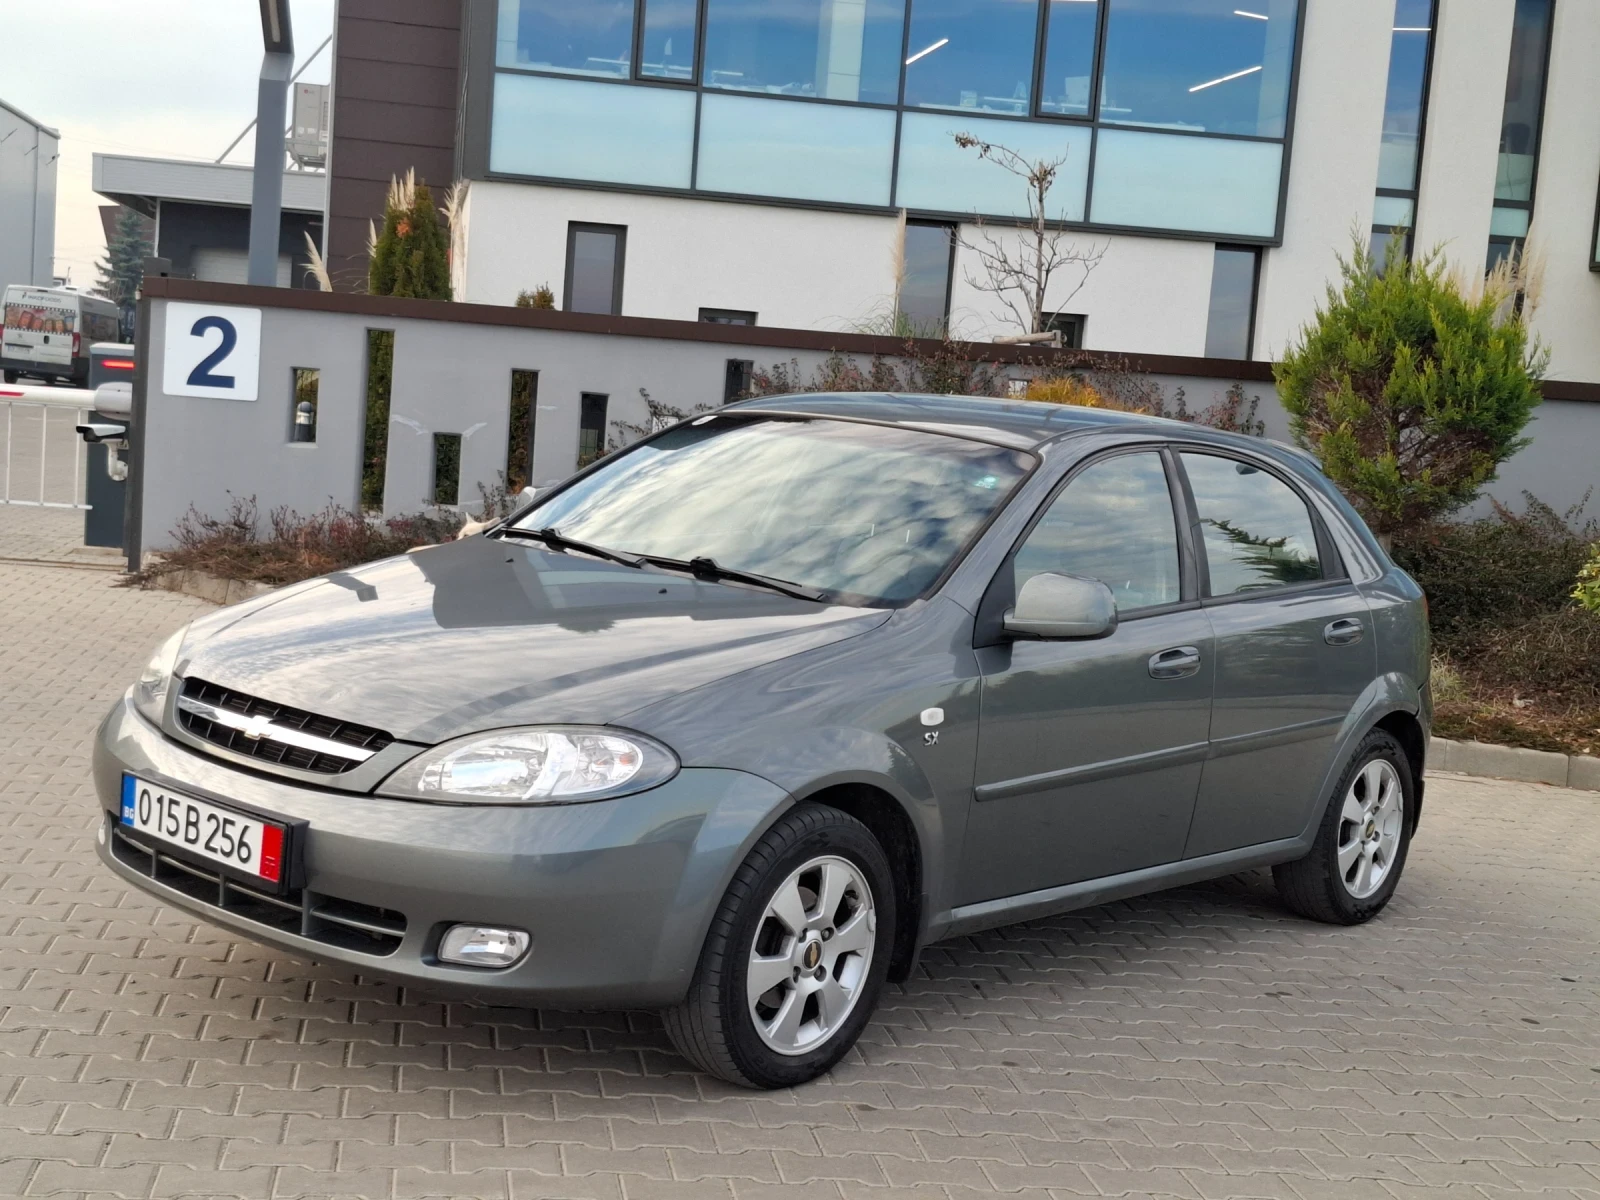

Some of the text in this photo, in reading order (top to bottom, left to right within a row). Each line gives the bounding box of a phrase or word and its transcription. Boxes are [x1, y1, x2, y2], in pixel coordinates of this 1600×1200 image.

[186, 316, 237, 388] 2
[924, 731, 939, 746] SX
[124, 806, 134, 819] BG
